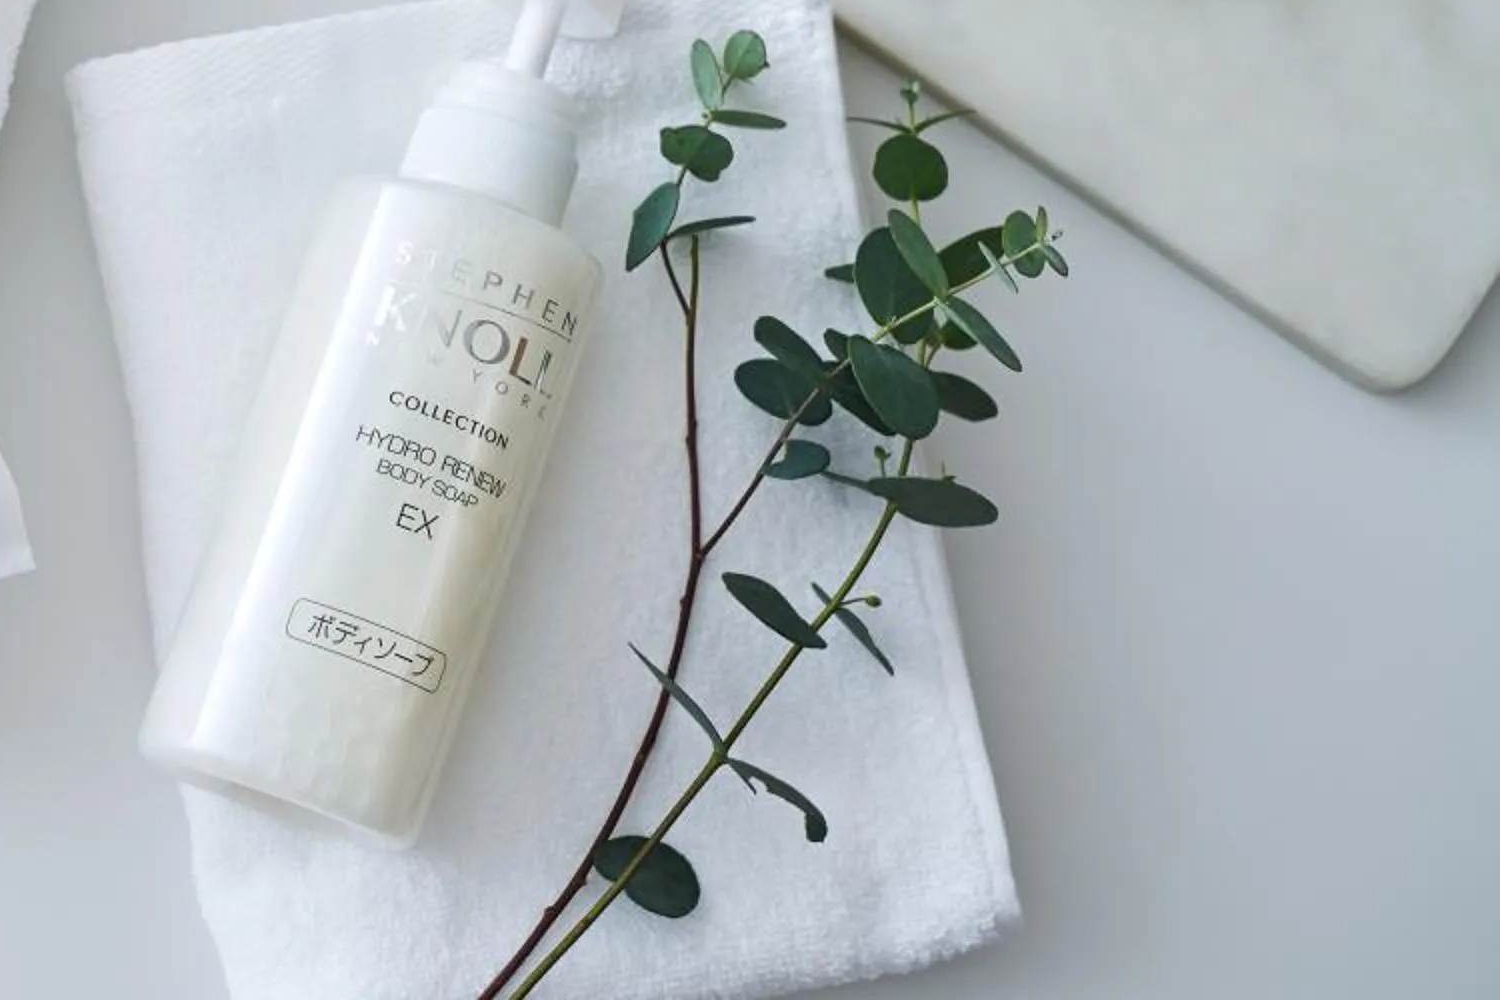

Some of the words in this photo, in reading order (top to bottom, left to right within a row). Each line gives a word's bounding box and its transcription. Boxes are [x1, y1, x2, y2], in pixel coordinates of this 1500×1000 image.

[396, 242, 578, 337] STEPHEN
[374, 284, 554, 400] KNOLL
[389, 391, 509, 449] COLLECTION
[355, 424, 437, 467] HYDRO
[440, 454, 506, 499] RENEW
[375, 458, 432, 489] BODY
[431, 478, 479, 507] SOAP
[396, 502, 440, 541] EX
[307, 614, 434, 676] ボディソープ
